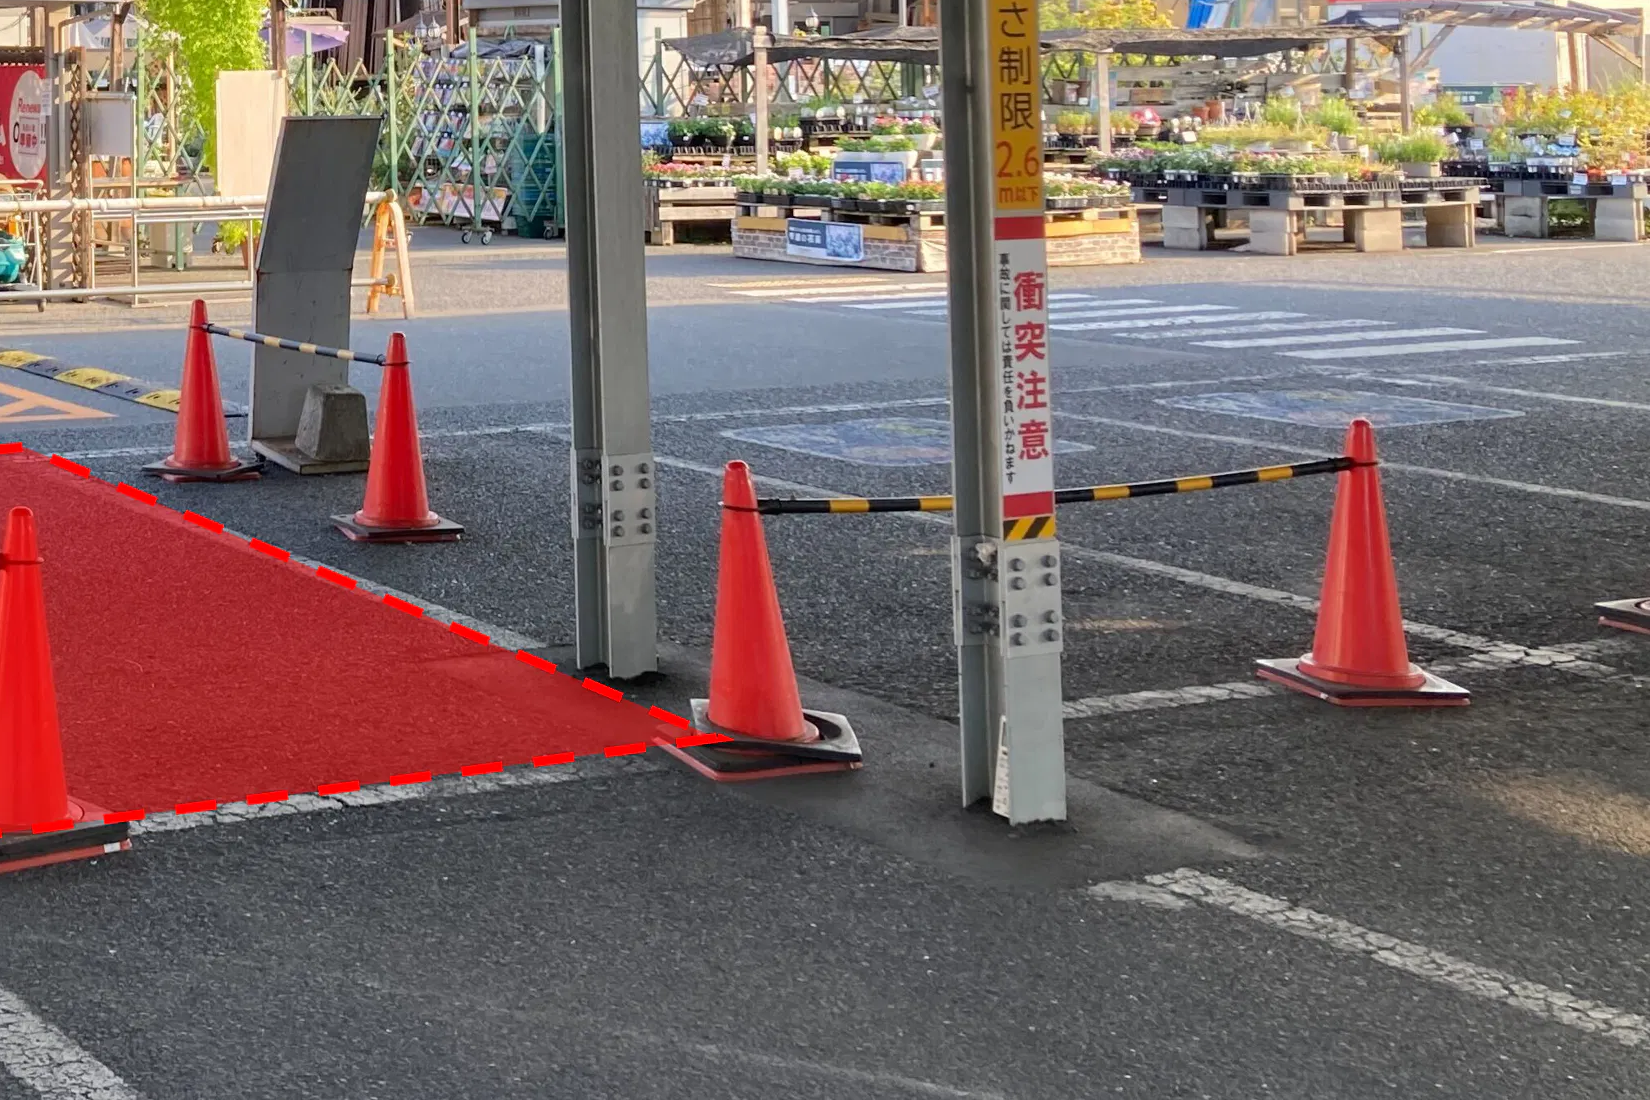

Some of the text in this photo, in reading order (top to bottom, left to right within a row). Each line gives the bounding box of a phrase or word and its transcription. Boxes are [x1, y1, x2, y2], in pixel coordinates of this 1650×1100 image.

[995, 141, 1040, 178] 2.6
[998, 186, 1039, 204] m以下
[1013, 270, 1049, 461] 衝突注意
